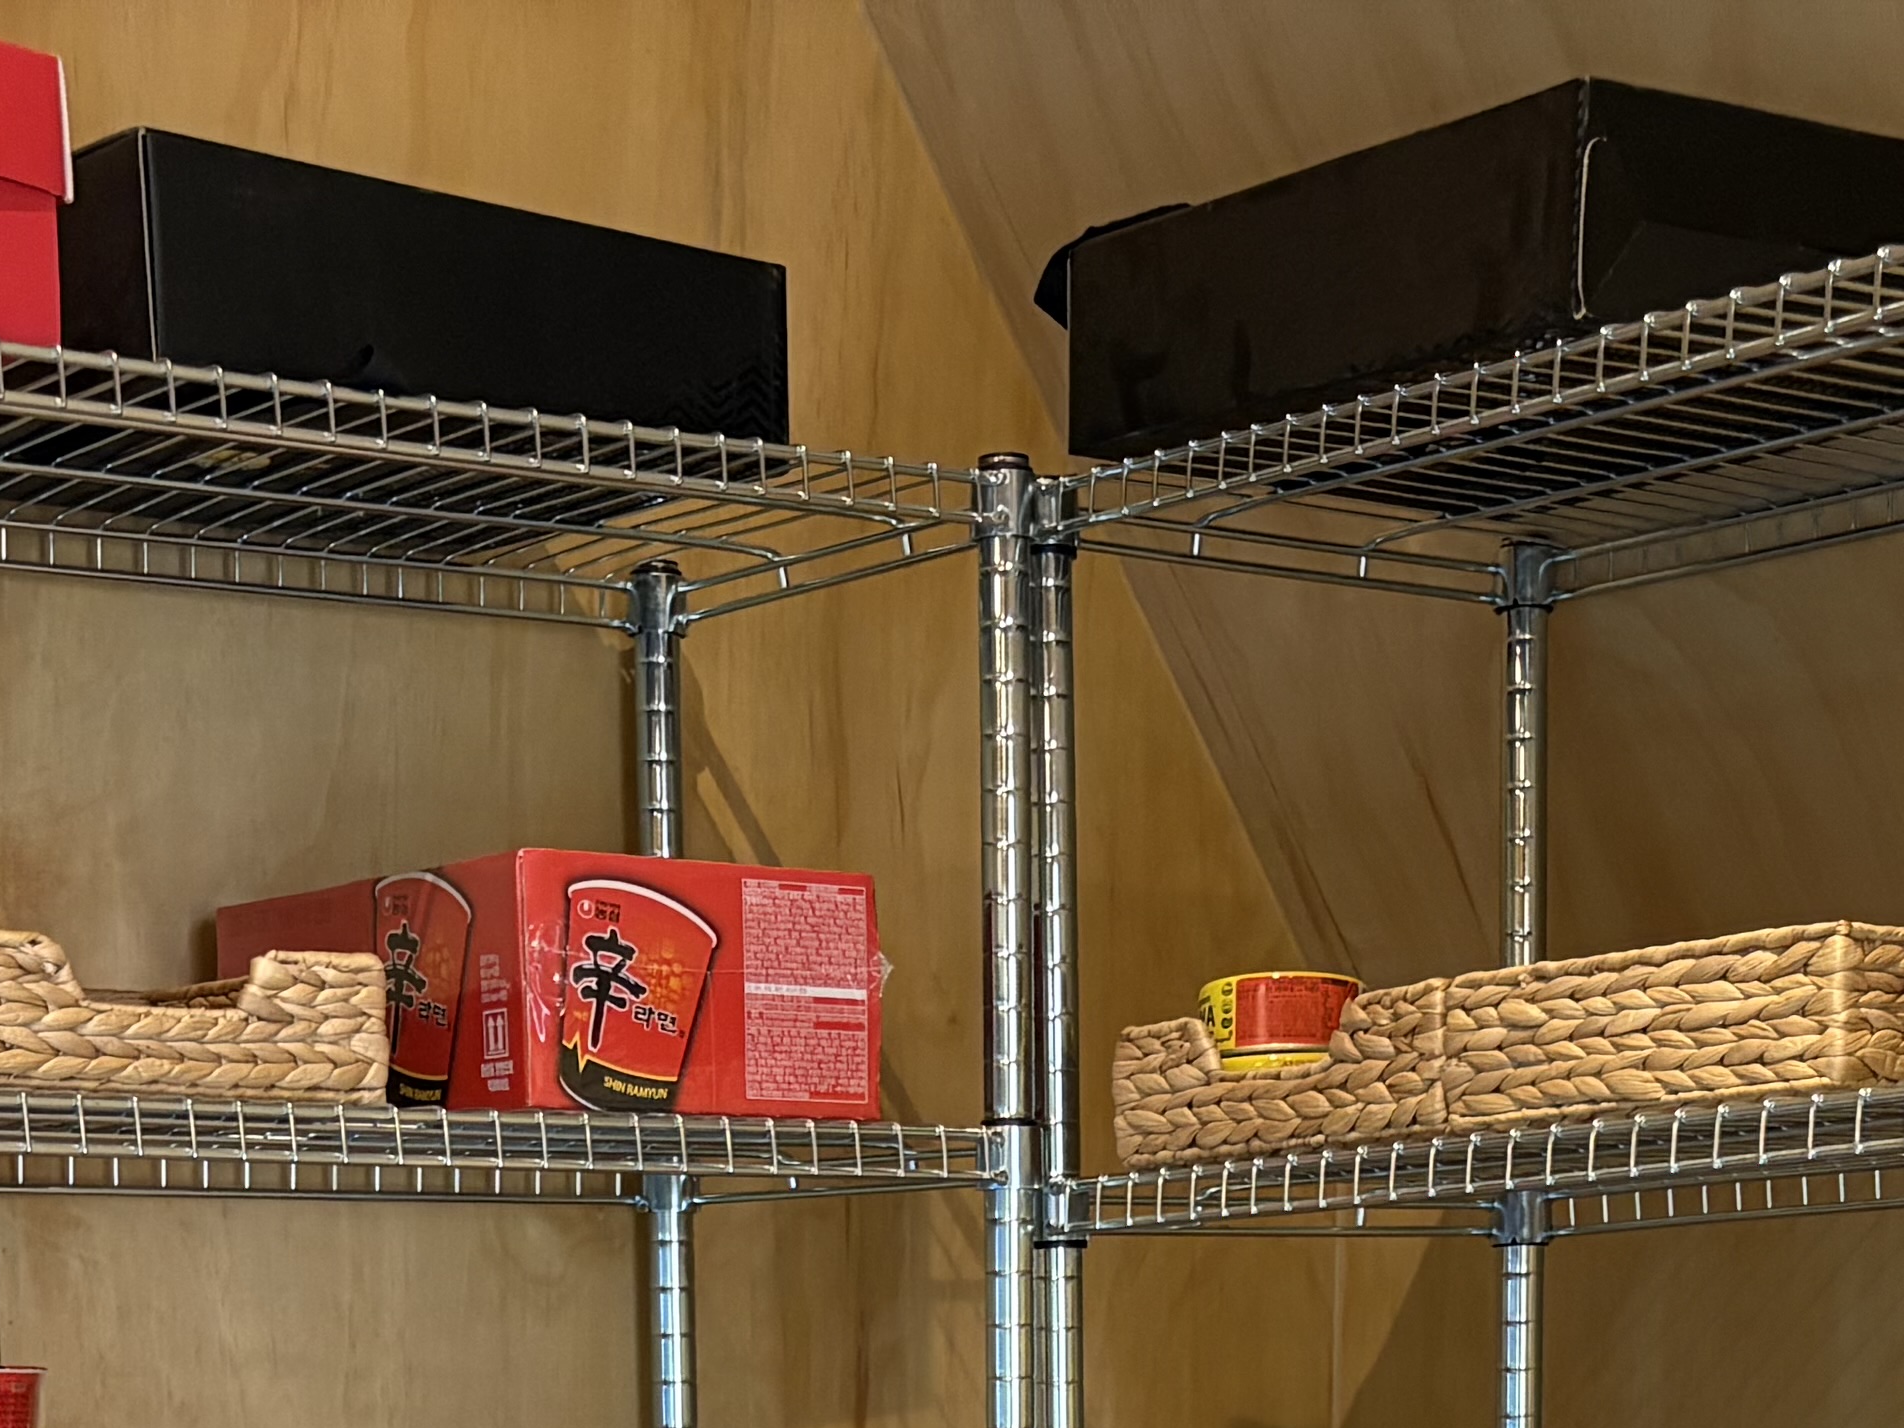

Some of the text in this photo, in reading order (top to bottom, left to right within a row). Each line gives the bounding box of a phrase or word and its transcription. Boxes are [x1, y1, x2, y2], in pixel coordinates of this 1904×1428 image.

[569, 926, 647, 1052] 辛
[417, 1000, 449, 1028] 라면
[632, 1004, 678, 1036] 라면
[604, 1075, 628, 1096] SHIN
